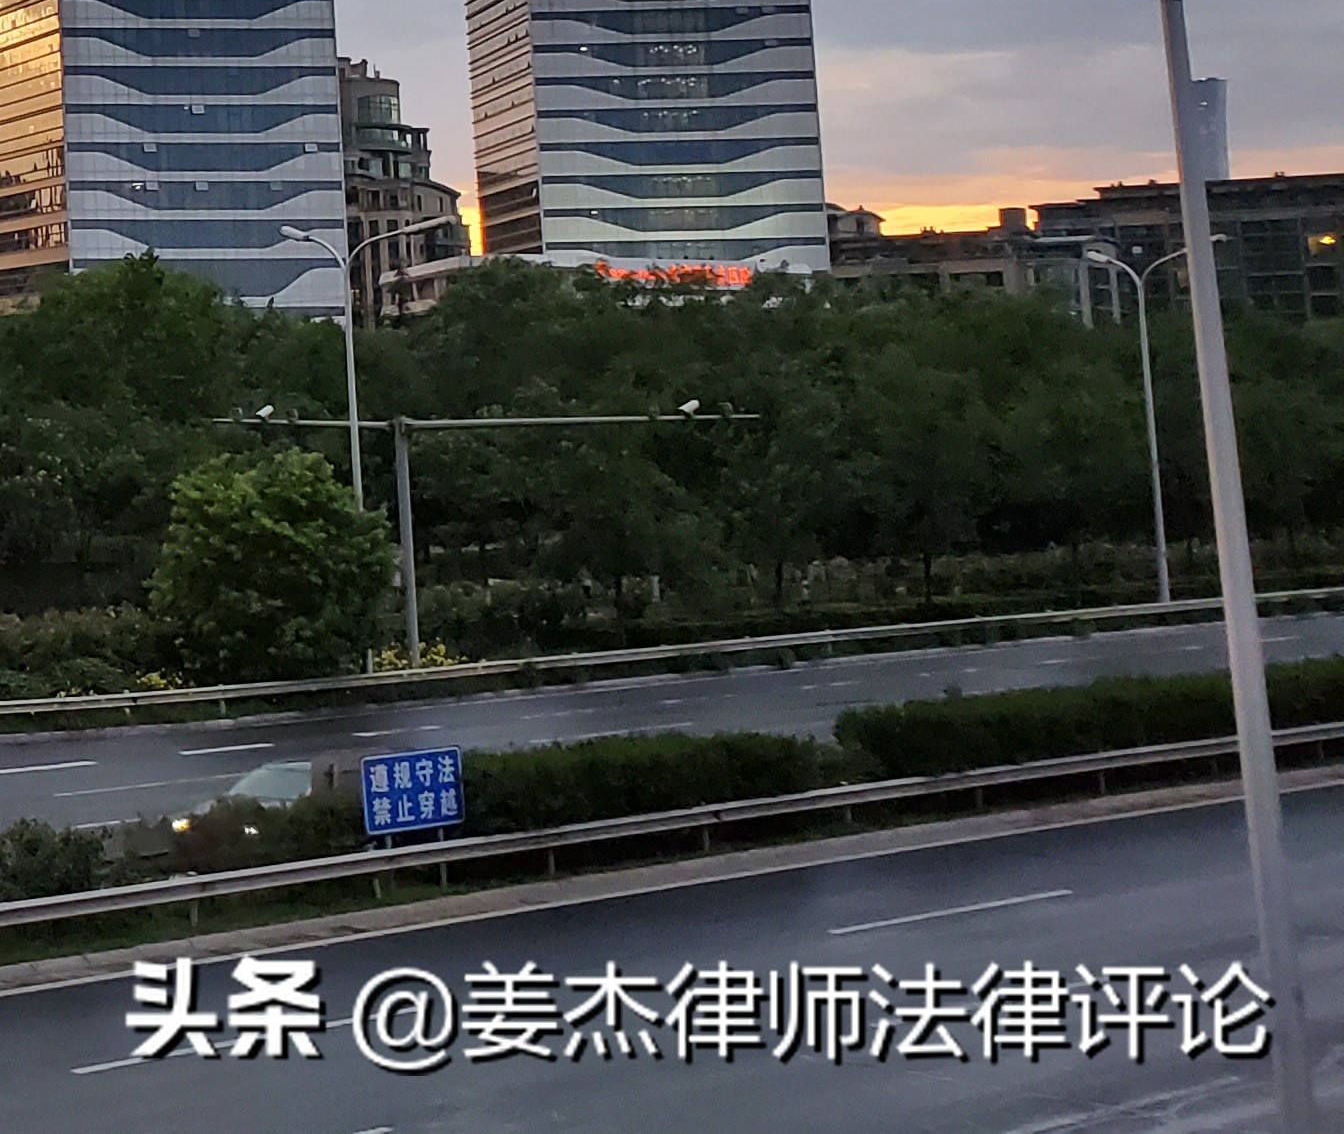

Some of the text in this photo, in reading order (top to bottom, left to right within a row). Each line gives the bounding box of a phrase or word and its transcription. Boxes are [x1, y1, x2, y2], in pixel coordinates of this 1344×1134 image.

[369, 754, 456, 794] 遵规守法
[372, 787, 459, 826] 禁止穿越
